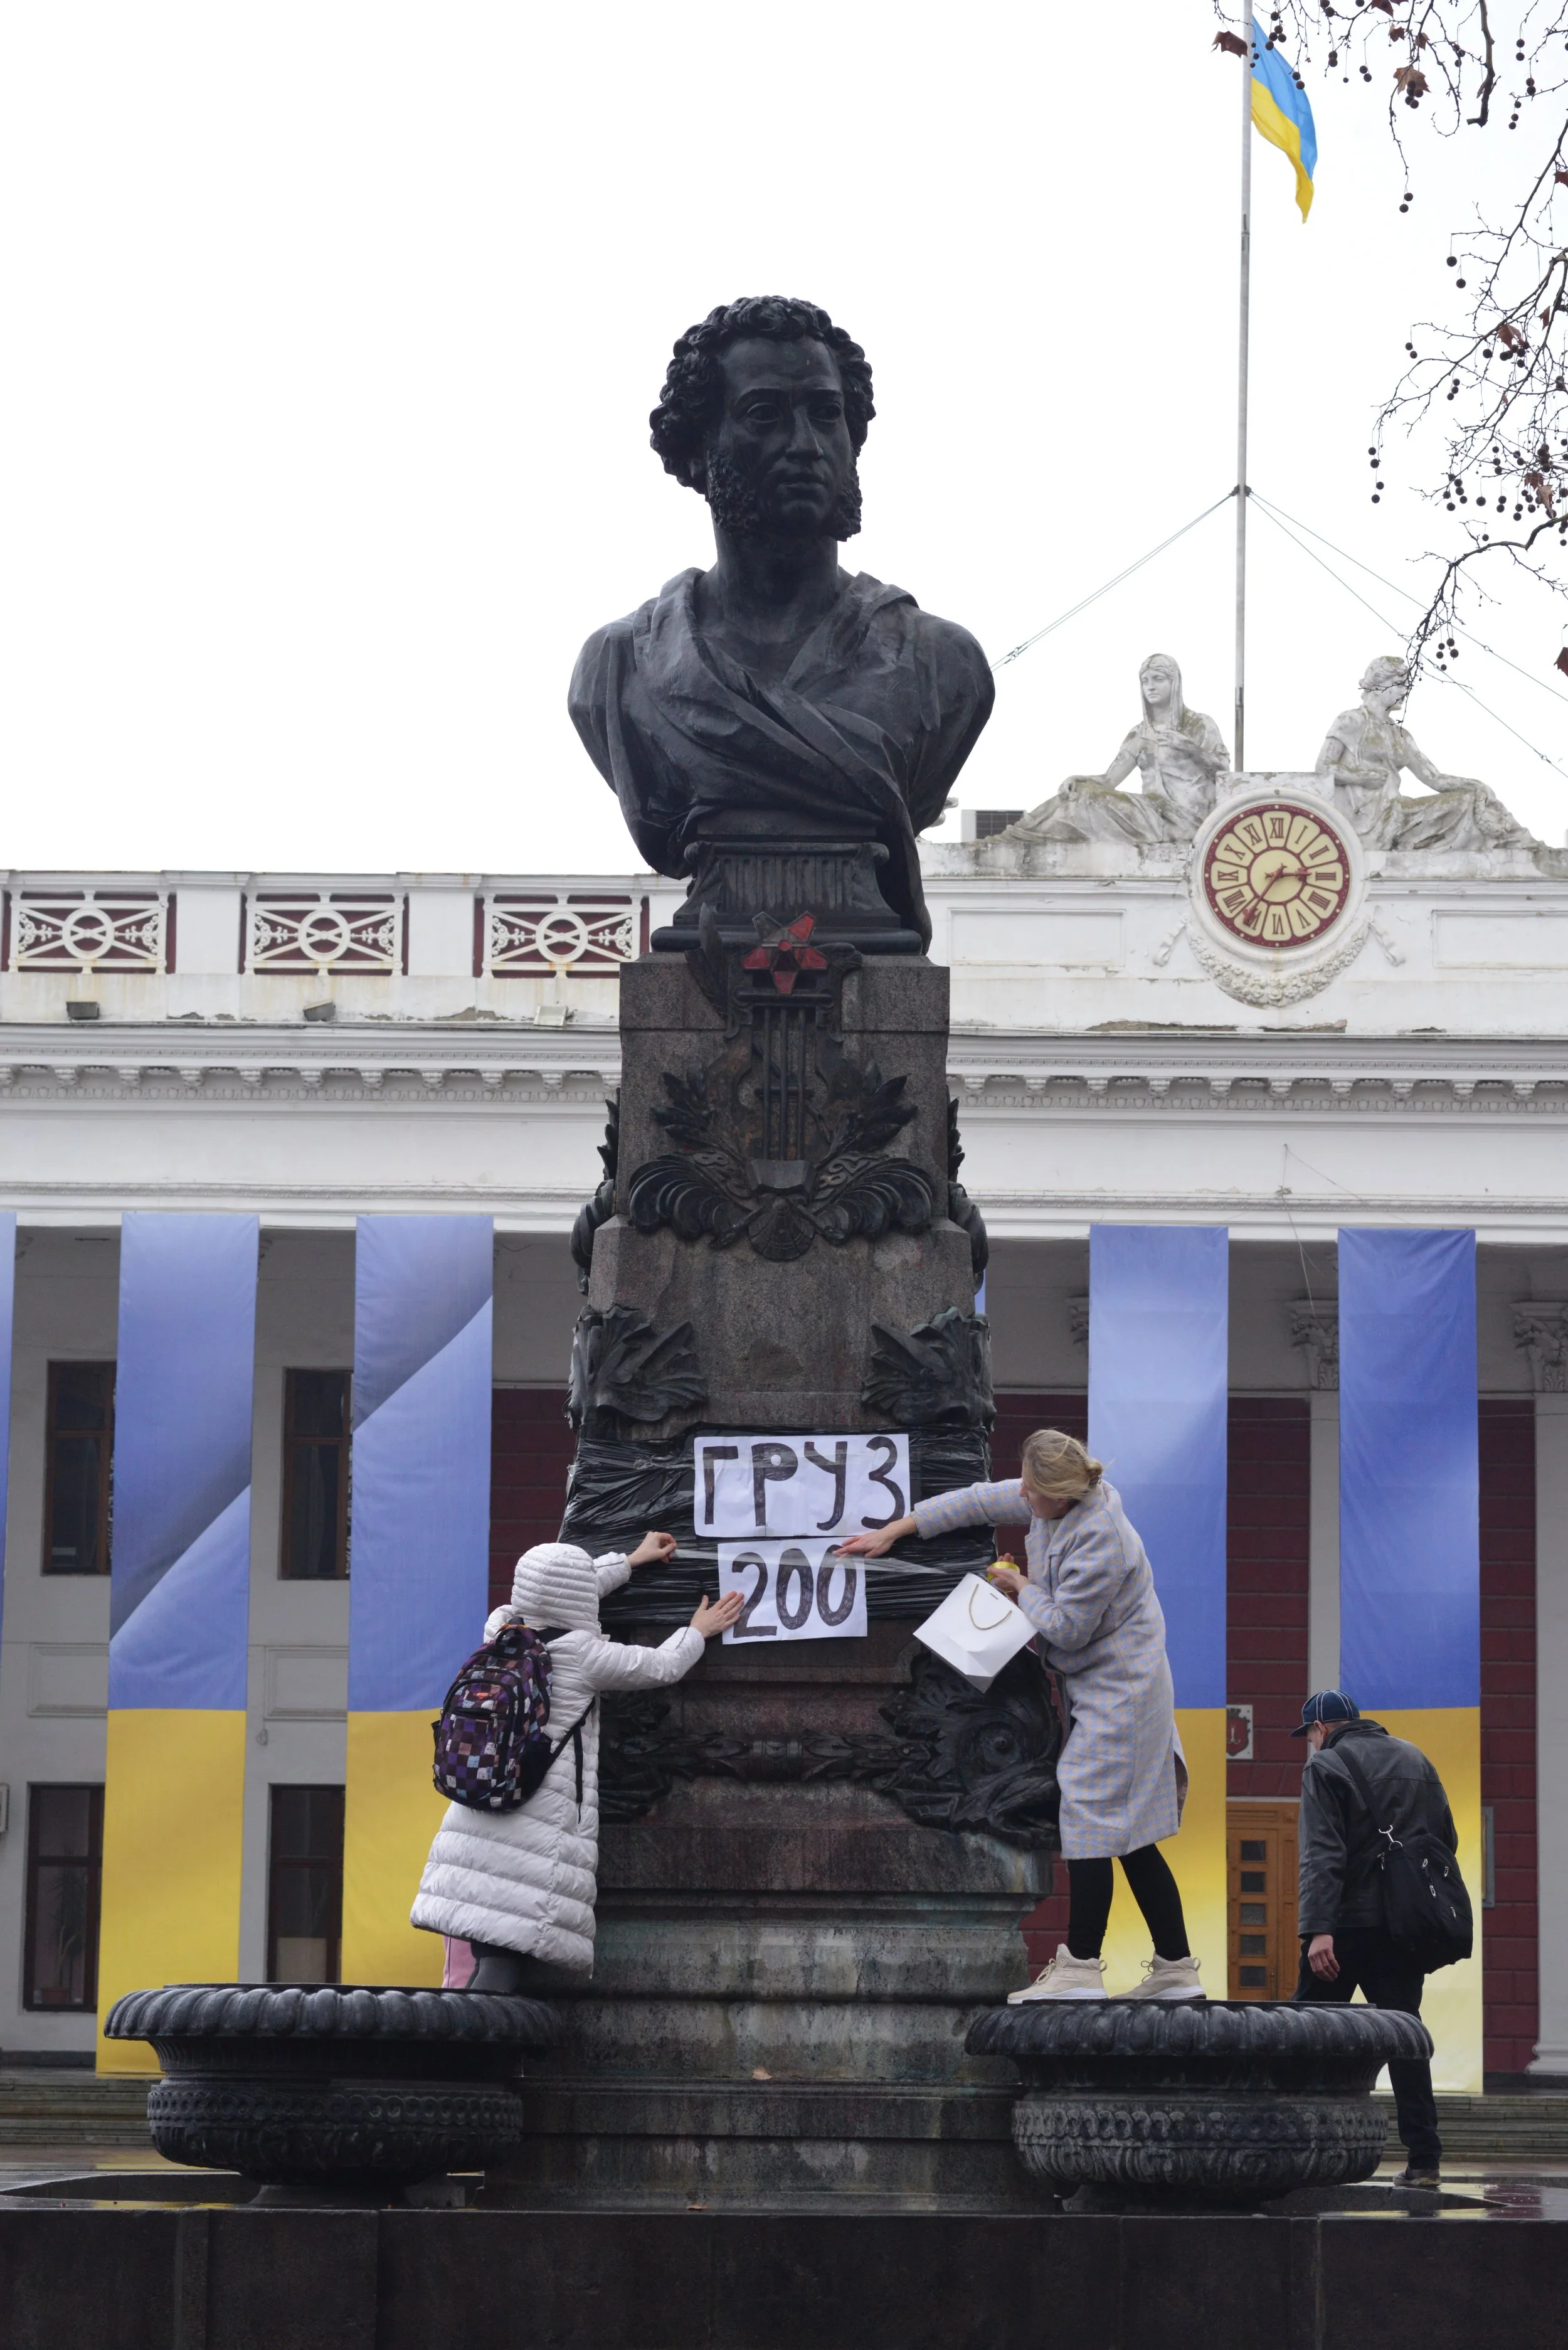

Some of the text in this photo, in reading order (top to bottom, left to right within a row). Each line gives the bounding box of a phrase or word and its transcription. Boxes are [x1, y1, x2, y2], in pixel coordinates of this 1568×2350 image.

[1243, 823, 1263, 846] XI
[1269, 817, 1285, 839] XII
[1224, 844, 1246, 861] X
[1309, 845, 1330, 861] II
[1217, 870, 1239, 881] IX
[1315, 871, 1337, 881] III
[1272, 913, 1285, 935] VI
[1296, 909, 1311, 929] V
[702, 1436, 905, 1531] ГРУЗ
[732, 1545, 857, 1638] 200
